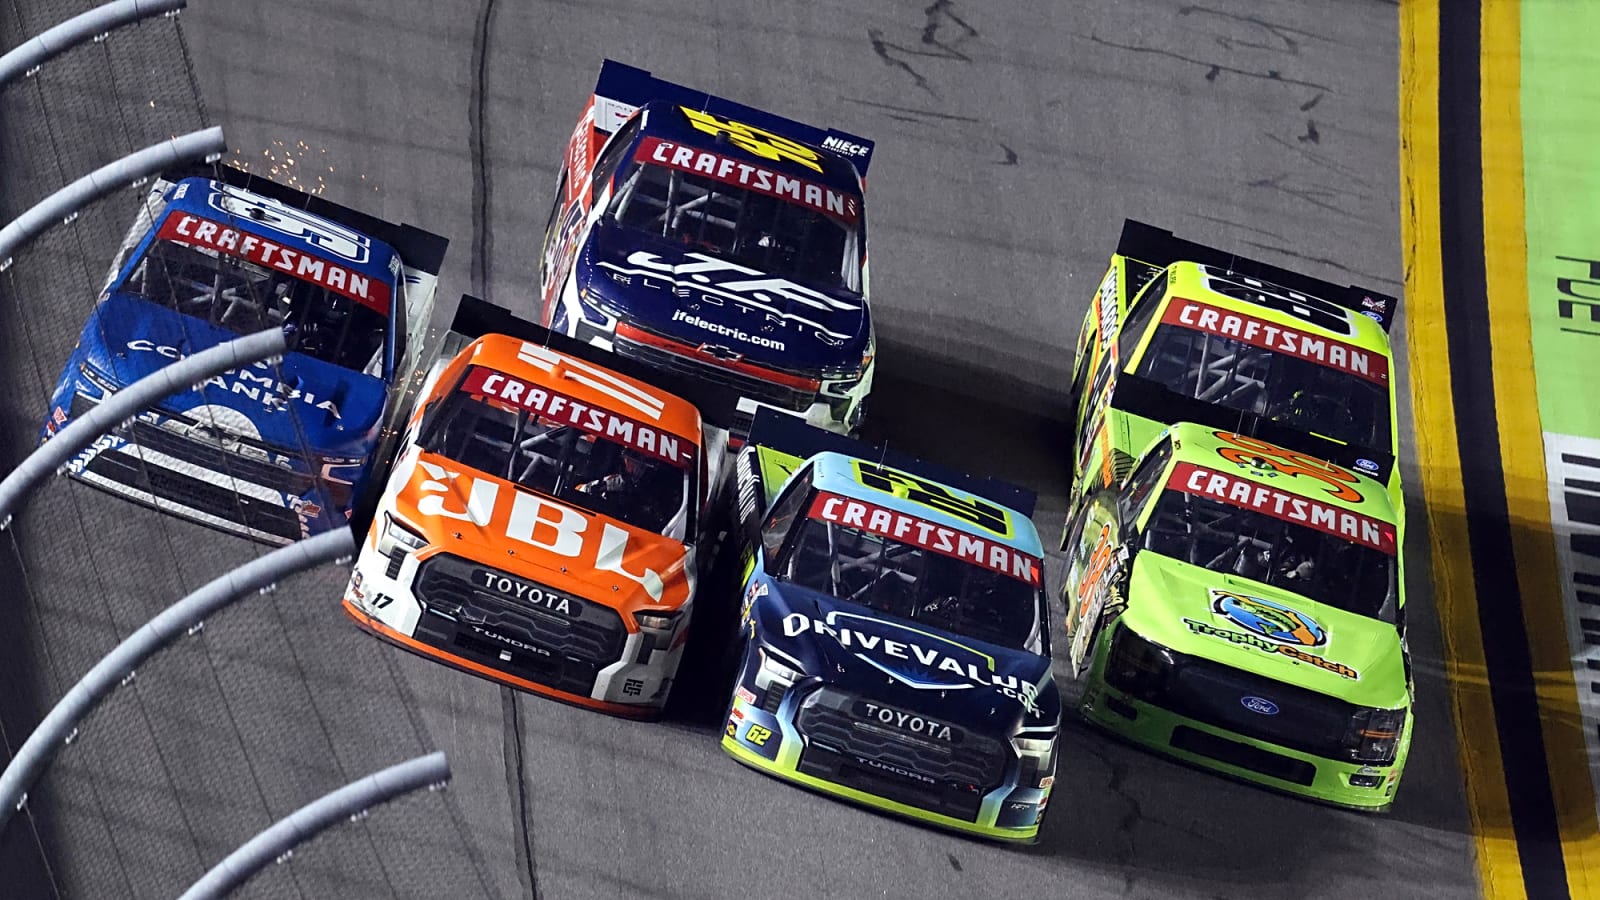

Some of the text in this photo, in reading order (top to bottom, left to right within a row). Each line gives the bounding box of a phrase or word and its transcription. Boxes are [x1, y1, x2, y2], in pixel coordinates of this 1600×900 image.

[823, 135, 870, 157] NIECE
[652, 142, 844, 216] CRAFTSMAN
[175, 215, 369, 299] CRAFTSMAN
[672, 309, 785, 351] jfelectric.com
[1179, 304, 1369, 375] CRAFTSMAN
[127, 339, 343, 420] COMBIA
[198, 375, 289, 411] ANK
[481, 374, 679, 462] CRAFTSMAN
[1212, 431, 1365, 503] 38
[1187, 470, 1380, 546] CRAFTSMAN
[822, 498, 1032, 581] CRAFTSMAN
[371, 592, 394, 609] 17
[485, 572, 571, 615] TOYOTA
[472, 625, 551, 657] TUNDRA
[1183, 617, 1359, 681] TrophyCatch
[866, 703, 952, 741] TOYOTA
[1245, 698, 1274, 713] Ford
[745, 724, 772, 746] 62
[856, 756, 936, 784] TUNDRA
